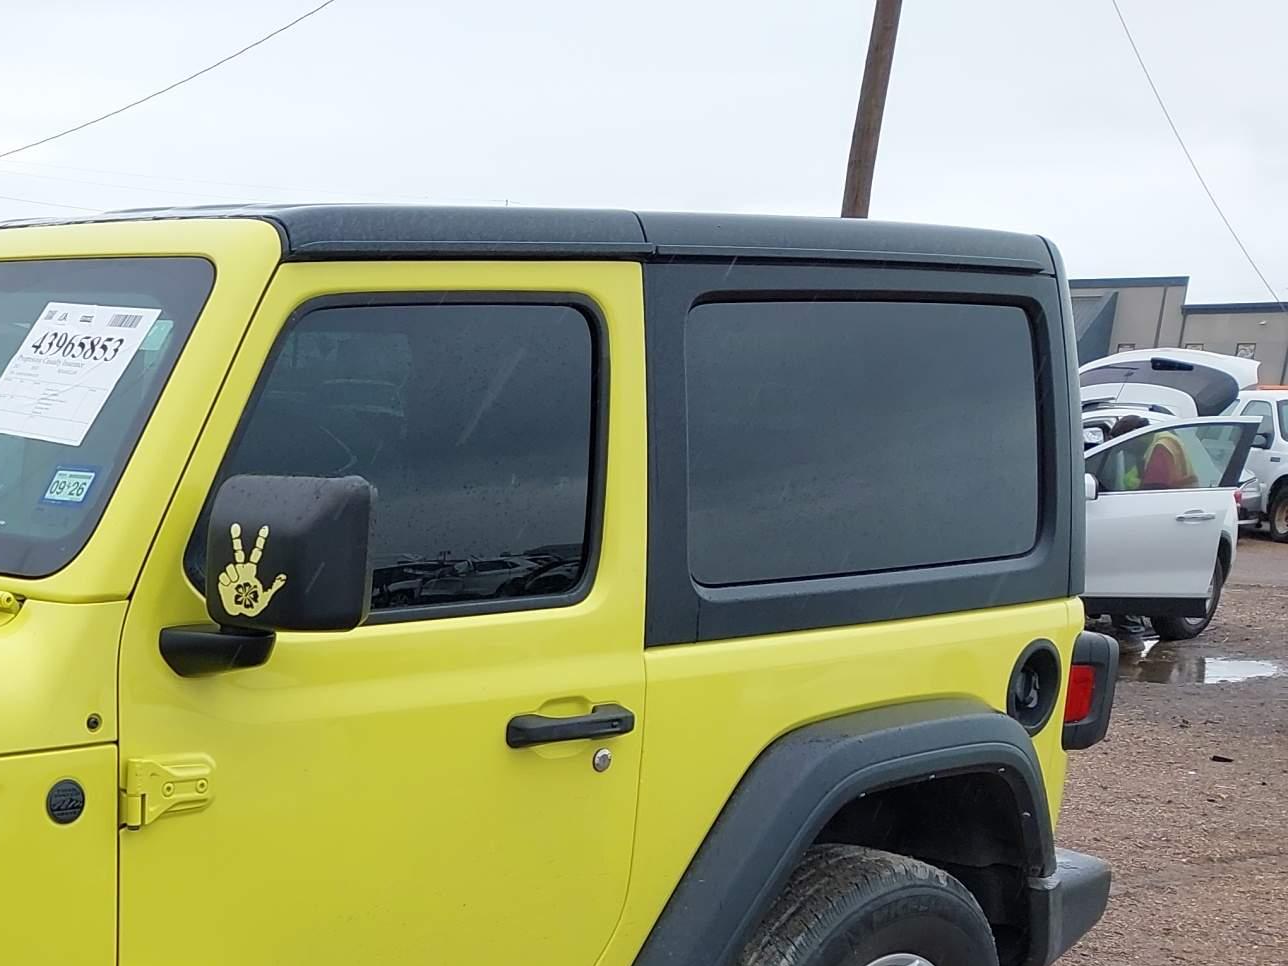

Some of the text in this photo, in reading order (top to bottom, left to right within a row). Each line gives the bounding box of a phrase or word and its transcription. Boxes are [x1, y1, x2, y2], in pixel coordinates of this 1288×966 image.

[32, 331, 124, 361] 43965853
[49, 480, 87, 497] 09 26
